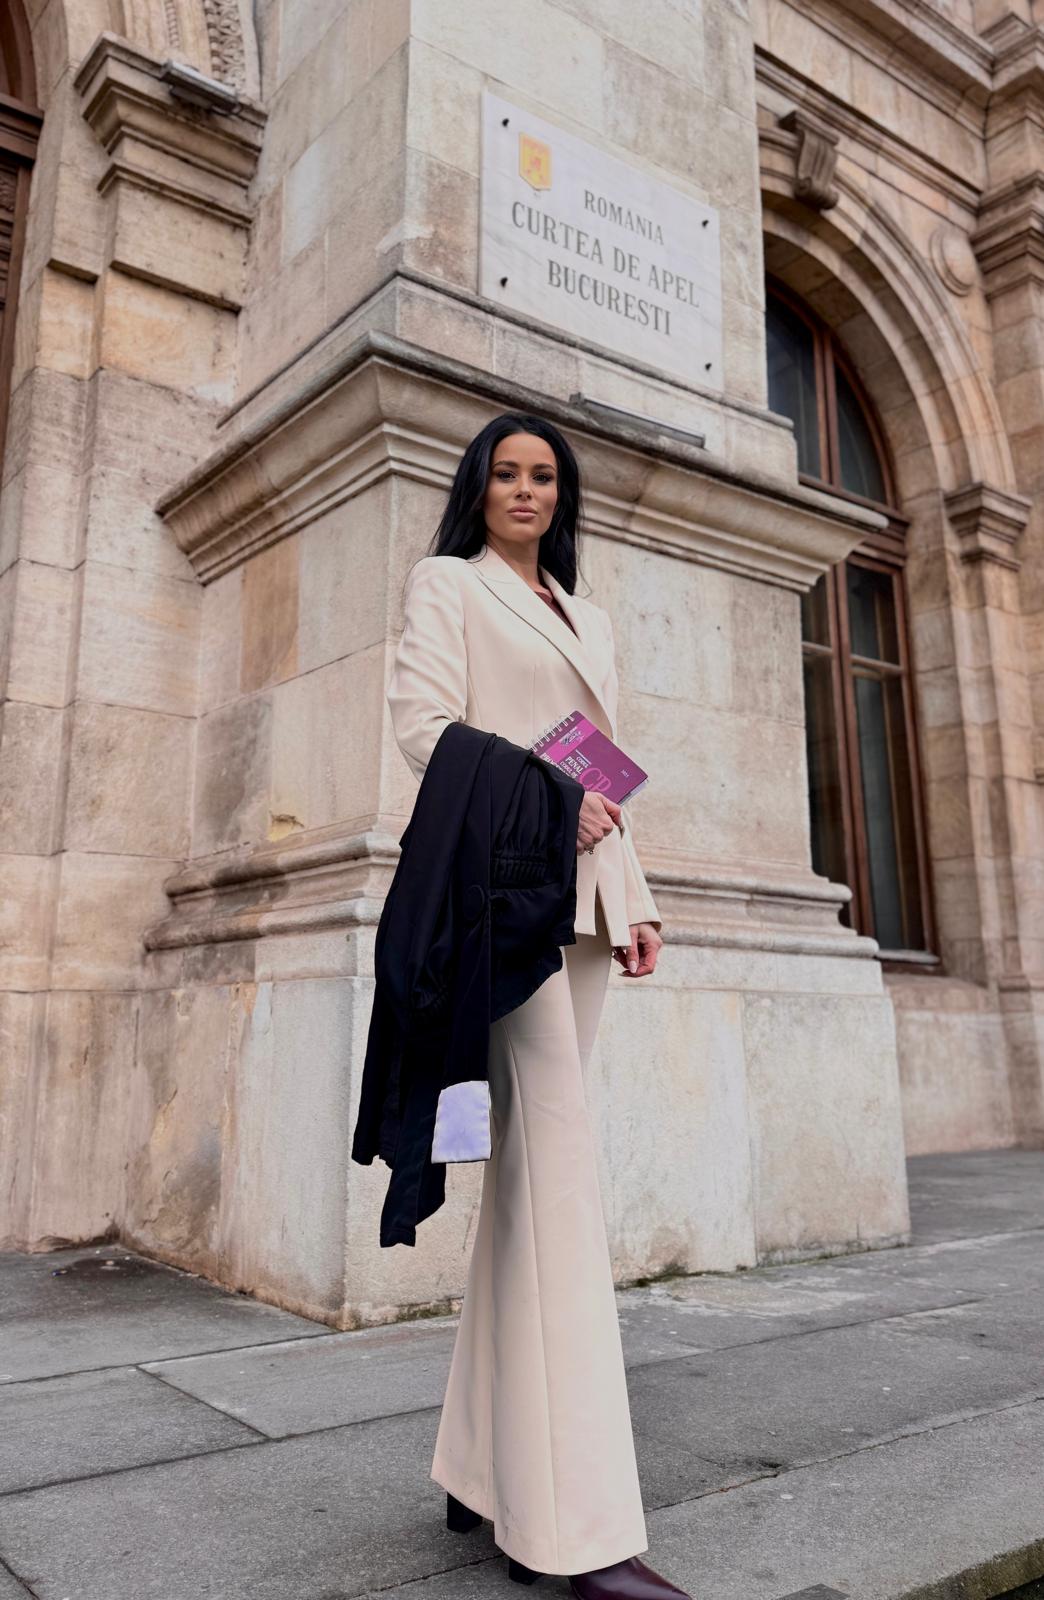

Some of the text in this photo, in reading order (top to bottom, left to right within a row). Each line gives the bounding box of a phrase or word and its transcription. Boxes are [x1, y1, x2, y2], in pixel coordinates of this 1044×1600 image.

[584, 189, 664, 245] ROMANIA
[511, 201, 699, 308] CURTEA DE APEL
[547, 259, 671, 336] BUCURESTI
[565, 756, 584, 775] PENAL
